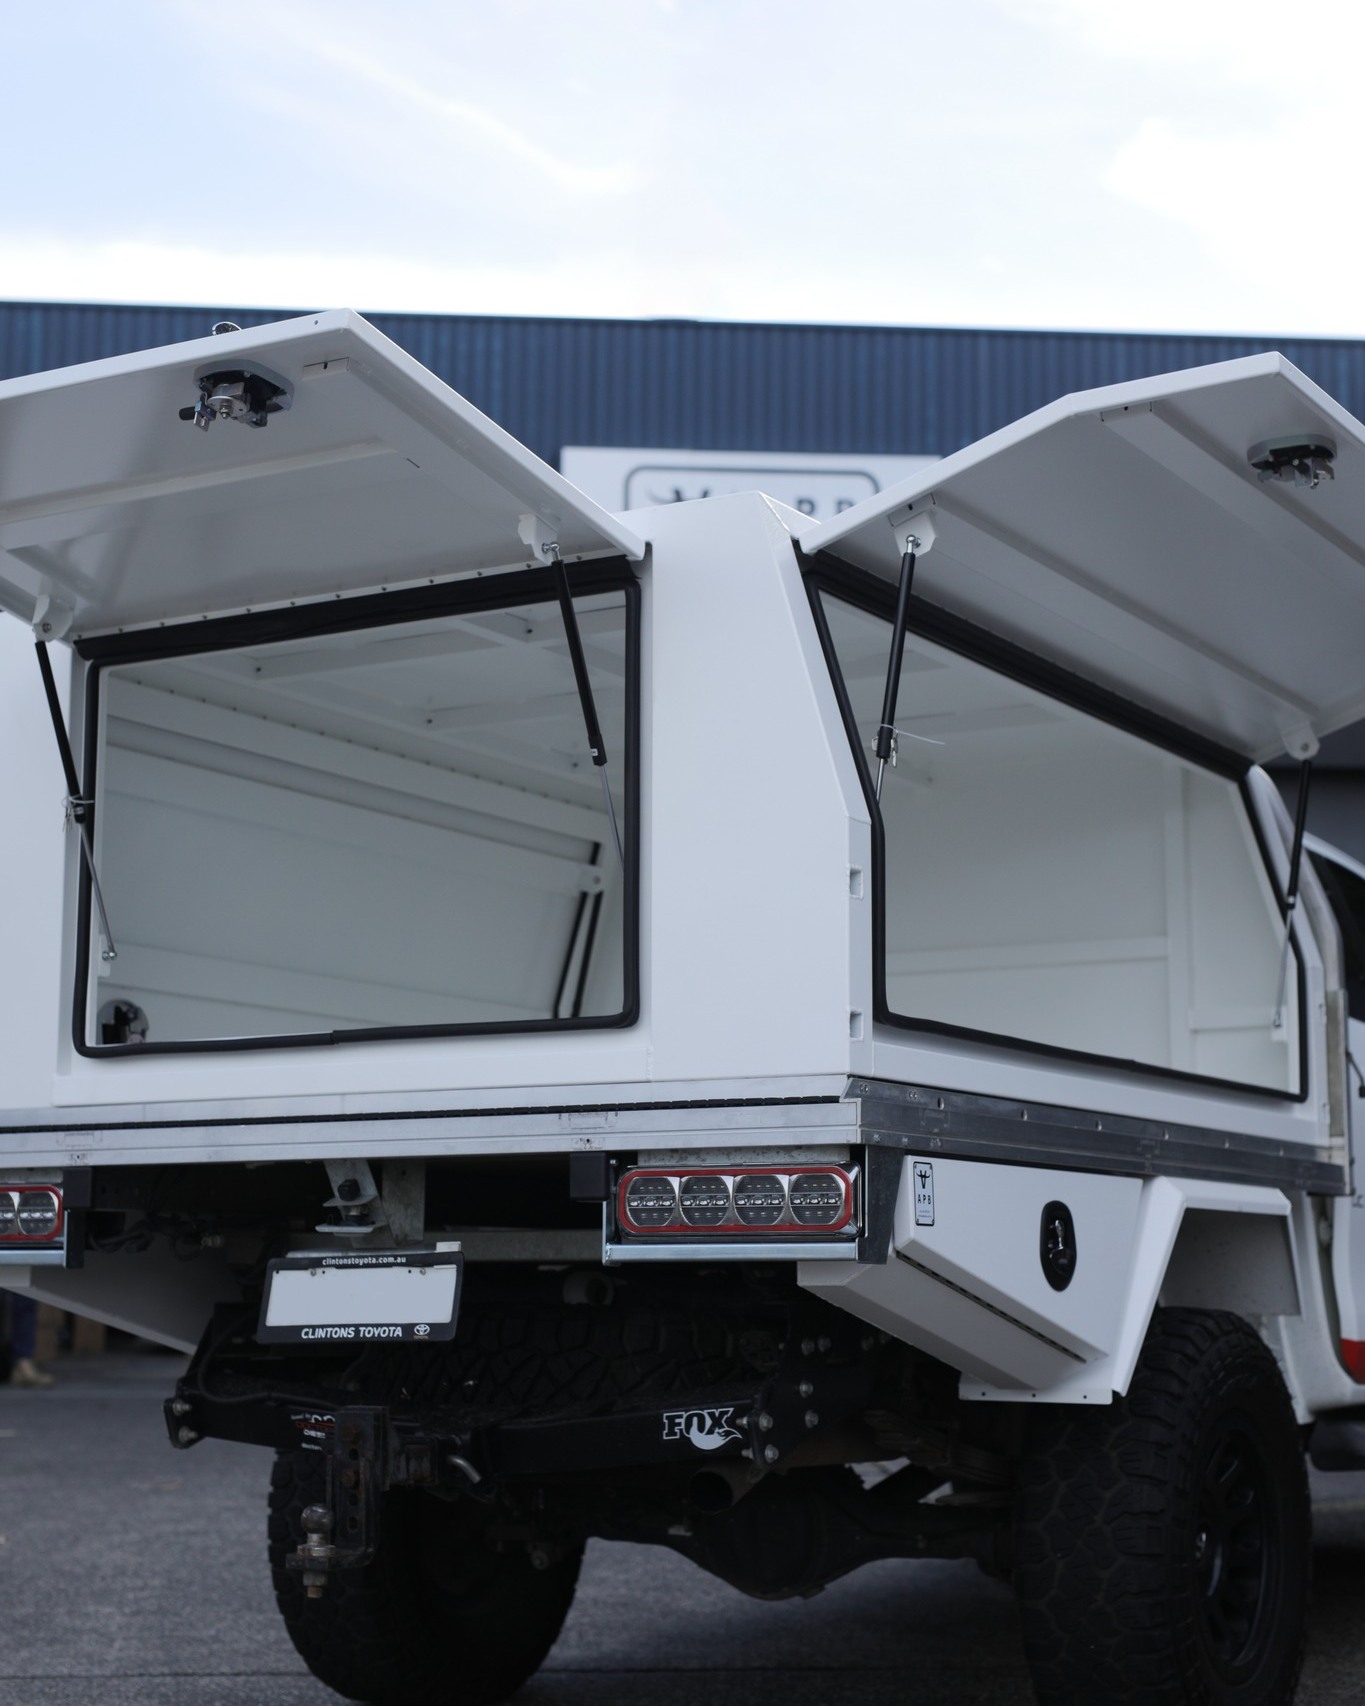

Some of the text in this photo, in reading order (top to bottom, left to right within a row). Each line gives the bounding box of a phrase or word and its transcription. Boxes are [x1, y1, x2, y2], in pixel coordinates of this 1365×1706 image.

[917, 1194, 931, 1204] APB
[322, 1256, 407, 1266] clintonstoyota.com.au
[301, 1327, 355, 1339] CLINTONS
[359, 1326, 402, 1338] TOYOTA
[663, 1408, 737, 1444] FOX
